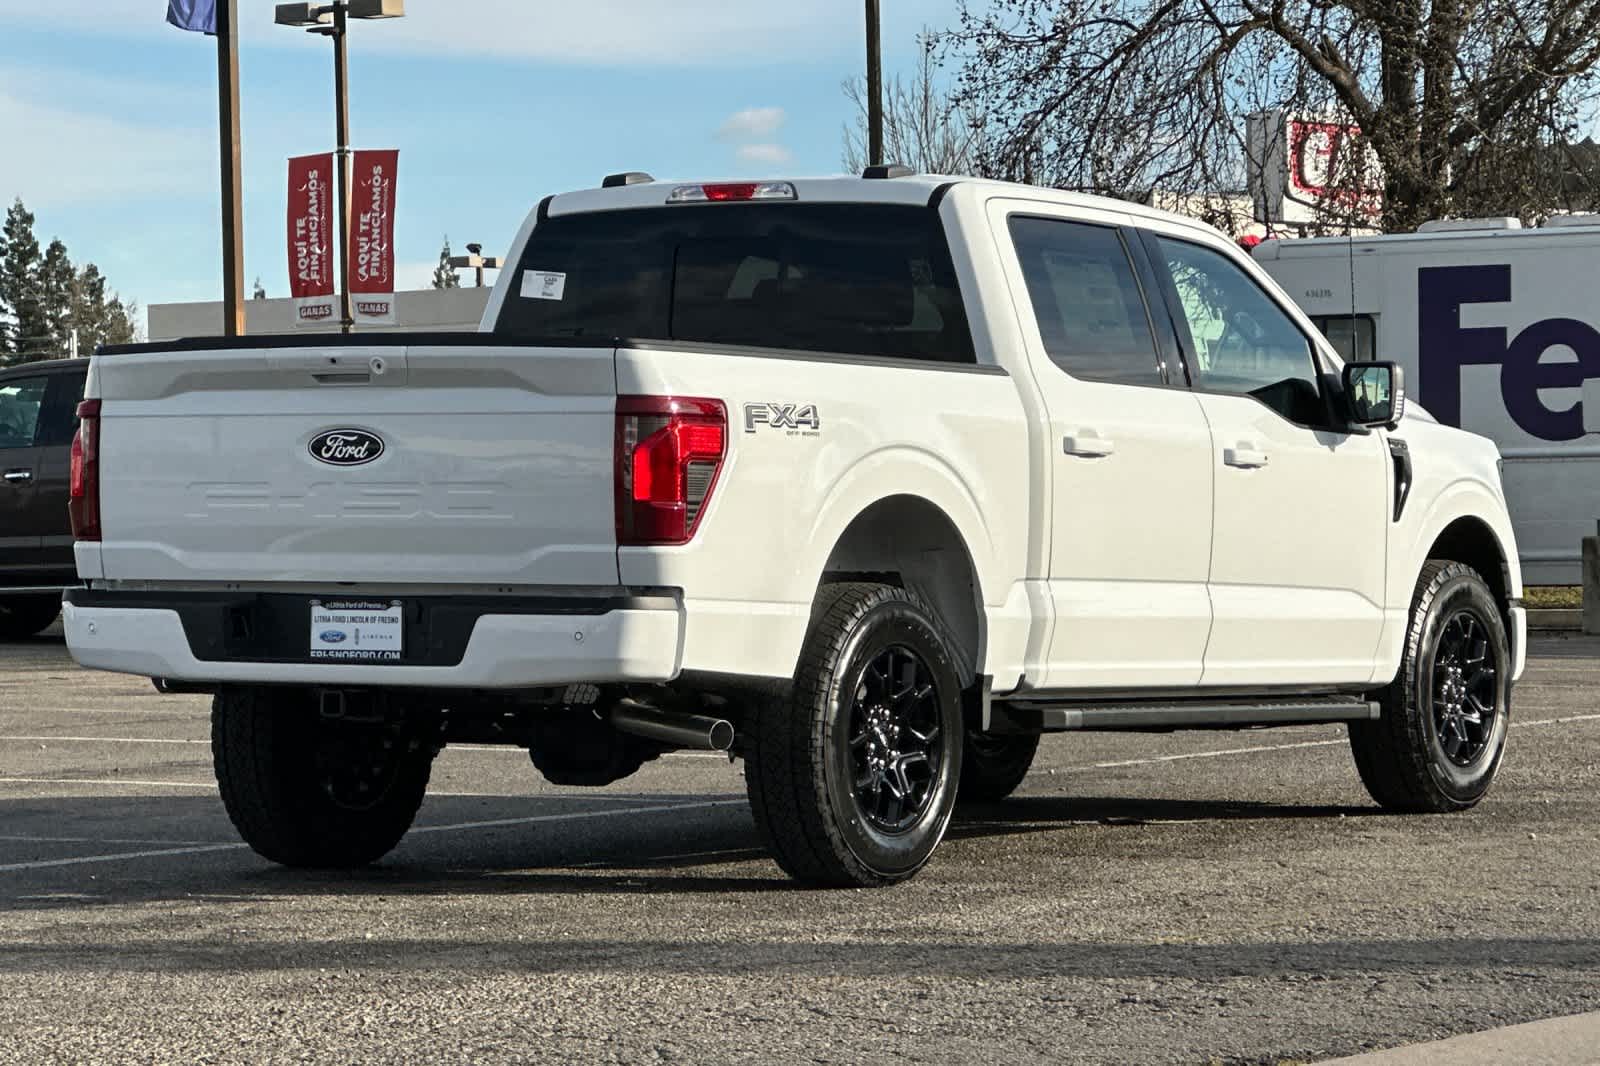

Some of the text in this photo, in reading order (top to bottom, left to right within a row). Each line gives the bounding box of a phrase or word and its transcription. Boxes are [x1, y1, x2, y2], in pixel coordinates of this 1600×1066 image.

[308, 169, 320, 280] FINANCIAMOS
[370, 165, 383, 277] FINANCIAMOS
[295, 216, 310, 280] AQUÍ TE
[357, 212, 371, 276] AQUÍ TE
[301, 305, 331, 317] GANAS
[358, 303, 387, 313] GANAS
[744, 402, 820, 433] FX4
[321, 434, 370, 458] Ford
[314, 615, 399, 624] LITHIA FORD LINCOLN OF FRESNO
